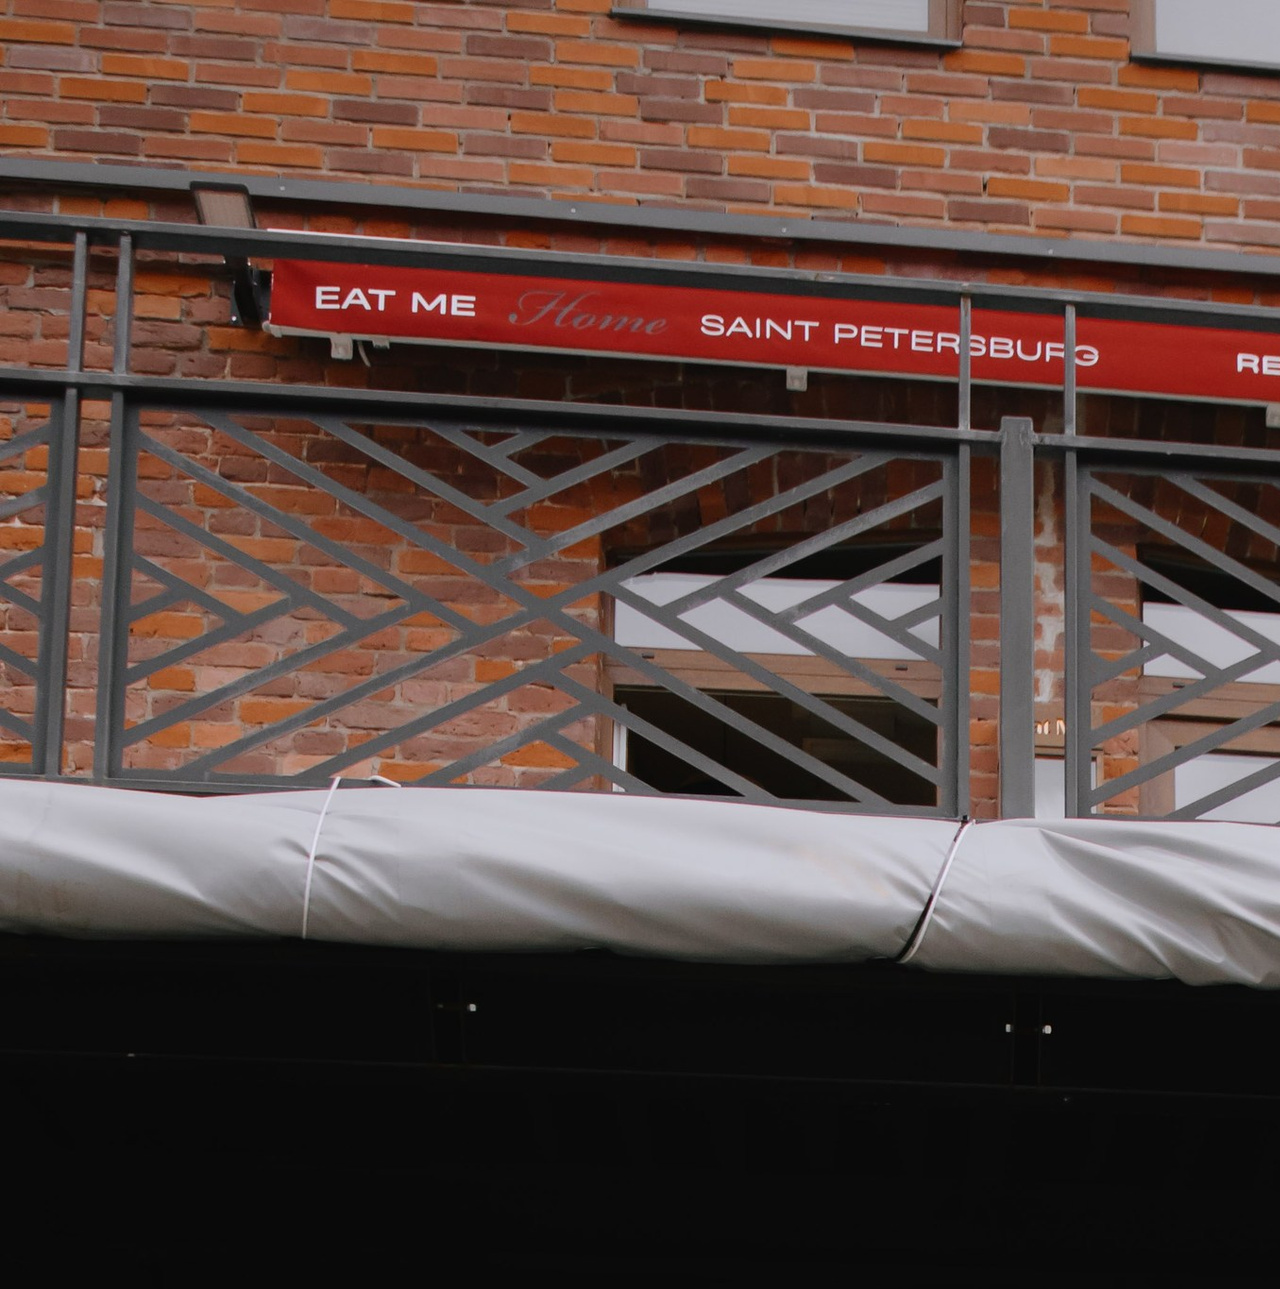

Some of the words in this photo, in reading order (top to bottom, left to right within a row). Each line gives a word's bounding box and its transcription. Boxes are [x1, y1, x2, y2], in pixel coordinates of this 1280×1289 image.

[315, 286, 396, 311] EAT
[412, 292, 476, 317] ME
[508, 289, 668, 335] Home
[700, 314, 819, 344] SAINT
[834, 323, 1100, 367] PETERSBURG
